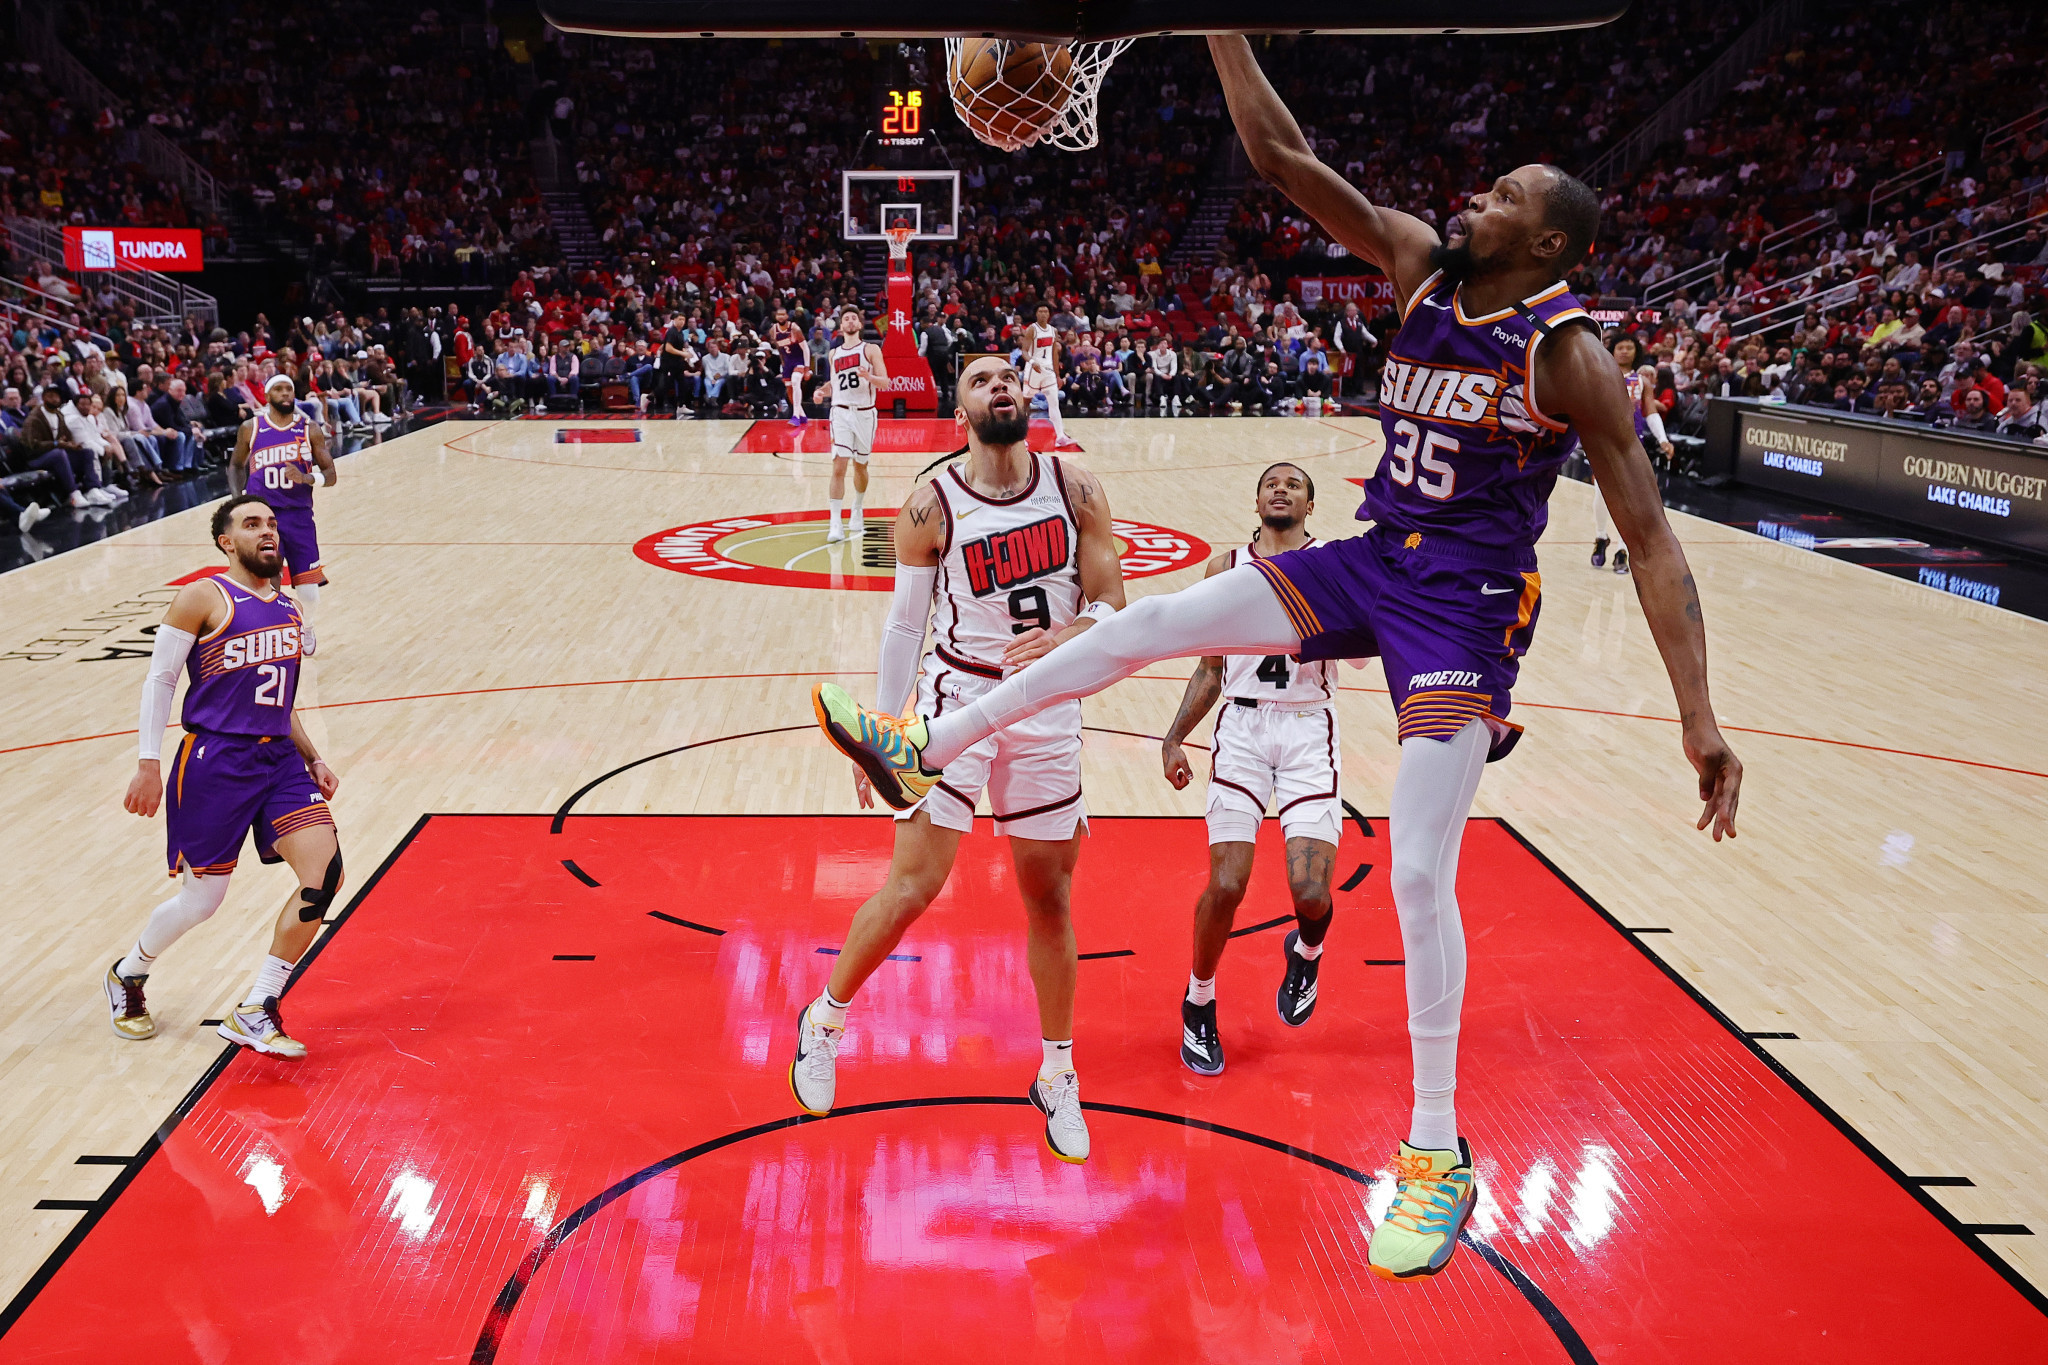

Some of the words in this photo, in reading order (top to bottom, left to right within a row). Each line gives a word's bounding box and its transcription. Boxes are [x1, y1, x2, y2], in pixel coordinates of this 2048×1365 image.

[889, 90, 922, 107] 7:16
[883, 106, 919, 134] 20
[119, 241, 187, 259] TUNDRA
[1326, 282, 1396, 299] TUNDR
[1590, 310, 1625, 322] GOLDEN
[1492, 326, 1528, 349] PayPal
[838, 371, 860, 391] 28
[1380, 357, 1497, 422] SUNS
[254, 443, 298, 470] SUNS
[1746, 427, 1794, 452] GOLDEN
[1794, 435, 1848, 462] NUGGET
[1390, 419, 1460, 500] 35
[1763, 451, 1785, 469] LAKE
[1785, 455, 1823, 477] CHARLES
[264, 467, 294, 489] 00
[1903, 455, 1970, 486] GOLDEN
[1971, 467, 2047, 501] NUGGET
[1927, 484, 1957, 506] LAKE
[1957, 490, 2011, 518] CHARLES
[962, 515, 1069, 598] H-TOWN
[1008, 586, 1050, 636] 9
[223, 627, 299, 670] SUNS
[254, 664, 288, 707] 21
[1256, 655, 1289, 689] 4
[1408, 670, 1483, 691] PHOENIX
